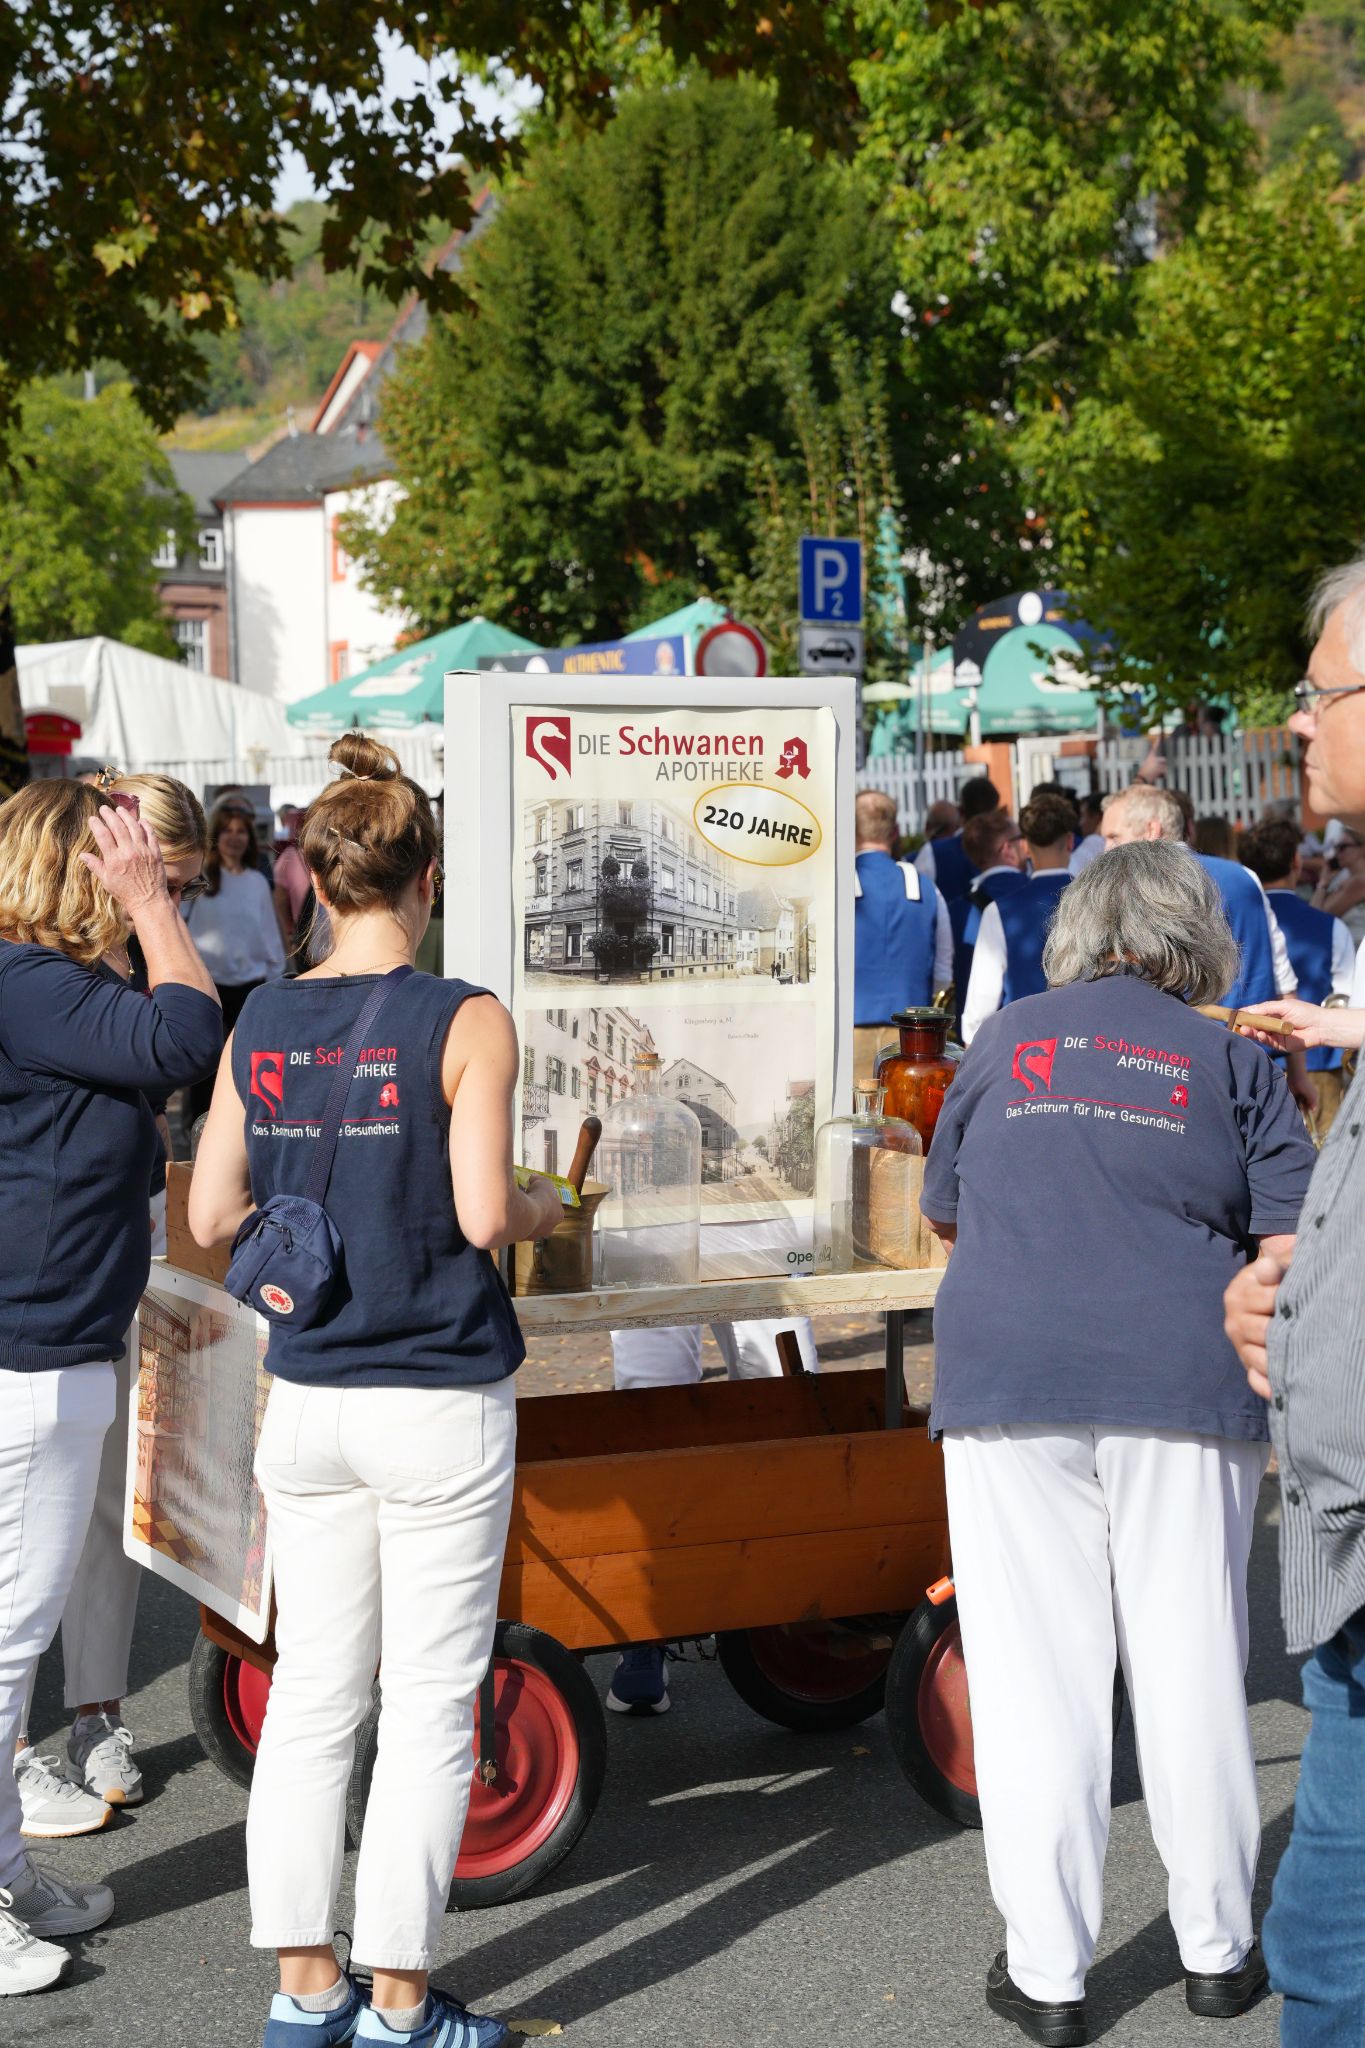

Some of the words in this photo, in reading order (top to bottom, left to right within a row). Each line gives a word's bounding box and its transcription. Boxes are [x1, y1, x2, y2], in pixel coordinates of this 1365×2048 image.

[814, 548, 848, 612] P
[830, 592, 844, 617] 2
[578, 734, 610, 755] DIE
[618, 726, 764, 756] Schwanen
[655, 761, 764, 781] APOTHEKE
[703, 805, 744, 830] 220
[747, 815, 813, 847] JAHRE
[290, 1051, 311, 1065] DIE
[315, 1046, 397, 1065] Schanen
[1064, 1036, 1089, 1049] DIE
[1094, 1035, 1192, 1068] Schwanen
[352, 1063, 397, 1078] OTHEKE
[1116, 1055, 1190, 1082] APOTHEKE
[252, 1125, 269, 1136] Das
[271, 1124, 303, 1138] Zentrum
[305, 1125, 322, 1138] für
[344, 1123, 400, 1137] Gesundheit
[1006, 1107, 1022, 1119] Das
[1024, 1102, 1069, 1115] Zentrum
[1073, 1102, 1090, 1116] für
[1094, 1105, 1116, 1120] Ihre
[1120, 1110, 1186, 1135] Gesundheit
[787, 1251, 814, 1265] Ope
